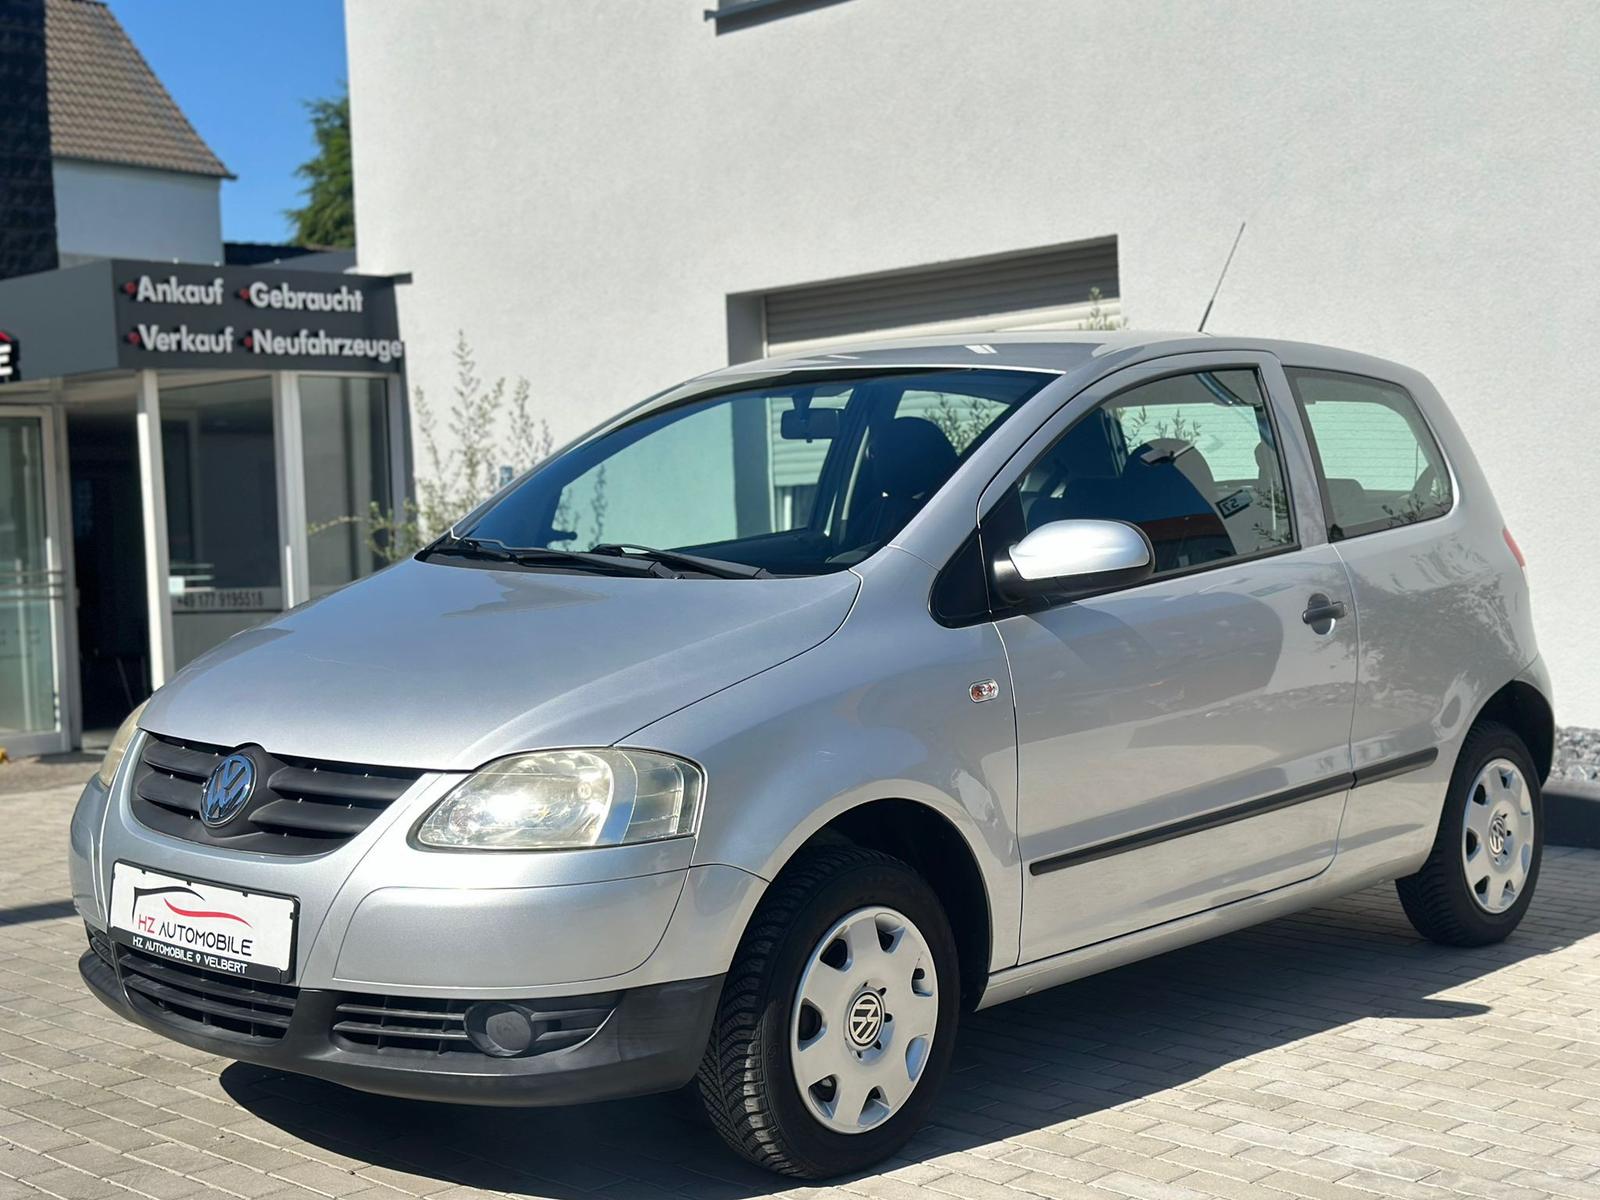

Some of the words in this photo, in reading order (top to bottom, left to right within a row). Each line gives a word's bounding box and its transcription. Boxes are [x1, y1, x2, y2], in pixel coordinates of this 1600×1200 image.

[136, 274, 225, 305] Ankauf
[249, 281, 363, 313] Gebraucht
[138, 323, 235, 354] Verkauf
[252, 328, 402, 364] Neufahrzeuge
[138, 914, 156, 934] HZ
[158, 921, 253, 956] AUTOMOBILE
[132, 936, 143, 947] HZ
[145, 940, 193, 962] AUTOMOBILE
[204, 955, 248, 974] VELBERT
